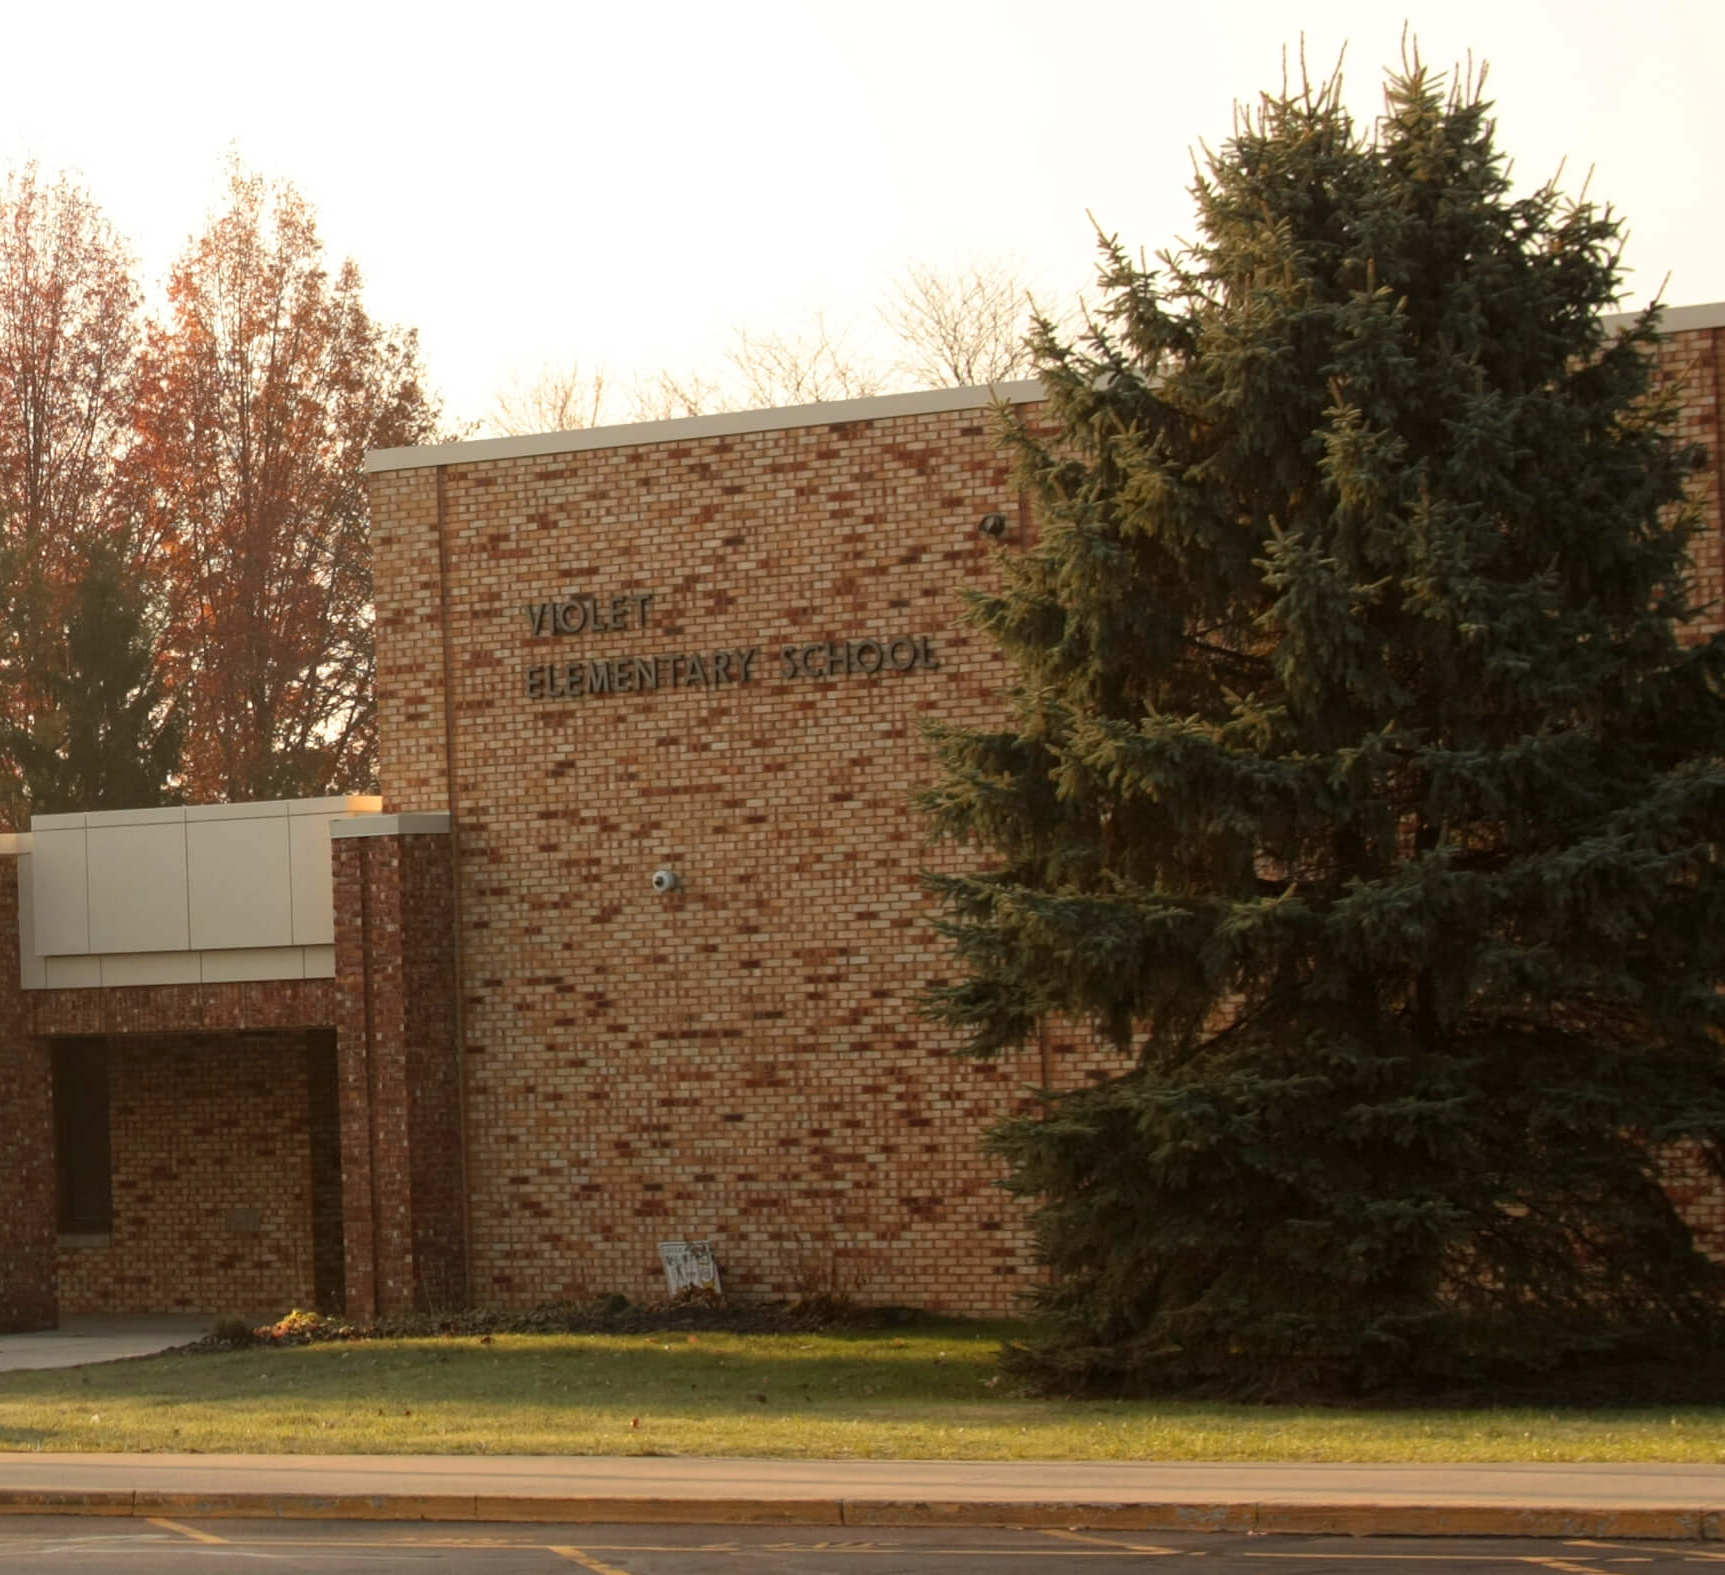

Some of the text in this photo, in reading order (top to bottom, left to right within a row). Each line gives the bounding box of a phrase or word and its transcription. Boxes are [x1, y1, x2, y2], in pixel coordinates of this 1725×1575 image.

[528, 594, 653, 636] VIOLET
[527, 636, 940, 699] ELEMENTARY SCHOOL
